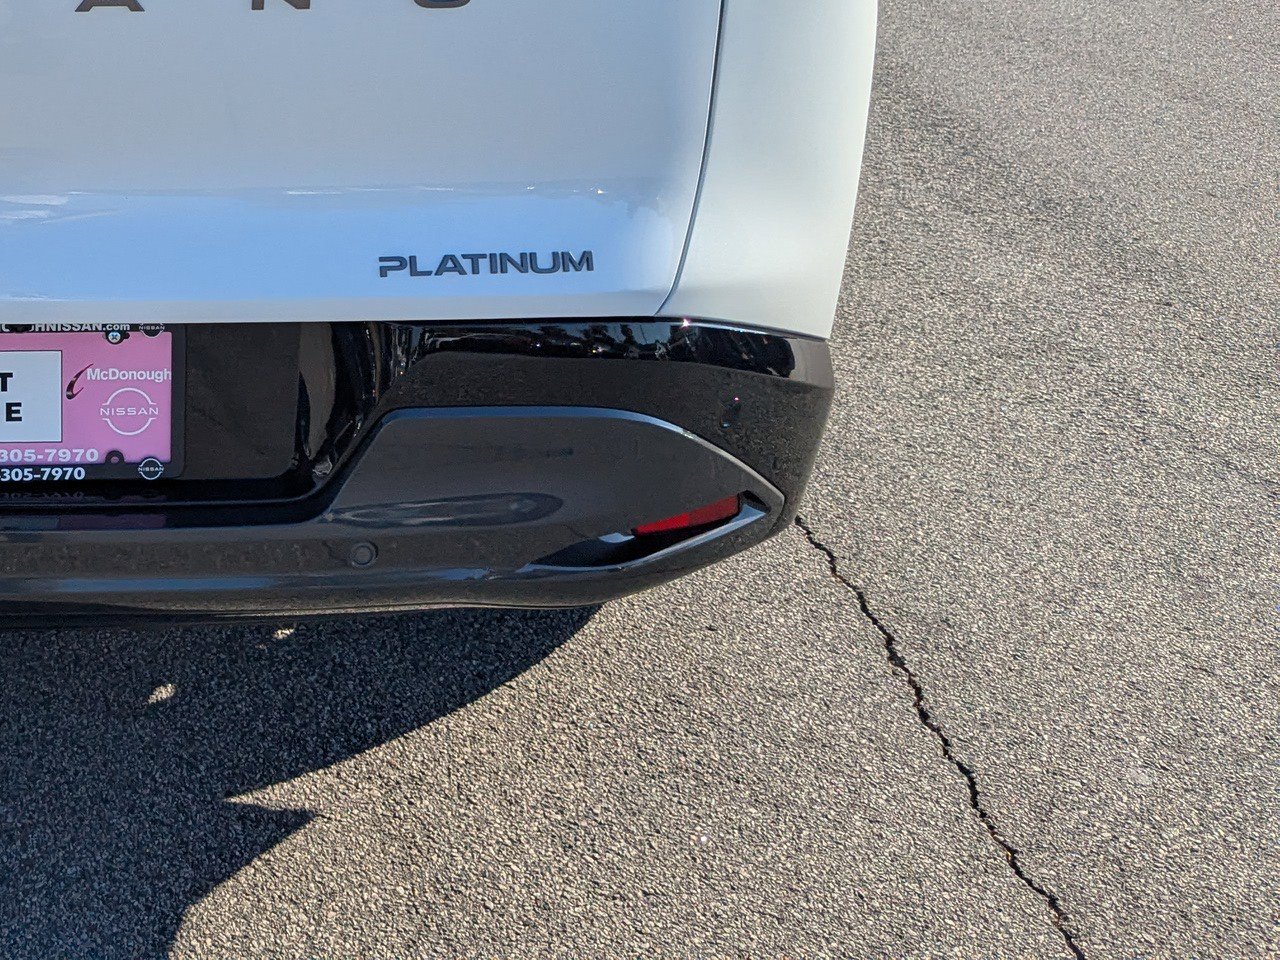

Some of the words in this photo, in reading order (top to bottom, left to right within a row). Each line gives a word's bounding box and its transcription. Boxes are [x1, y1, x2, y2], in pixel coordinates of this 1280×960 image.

[378, 250, 595, 278] PLATINUM
[86, 367, 172, 383] McDonough
[99, 407, 159, 417] NISSAN
